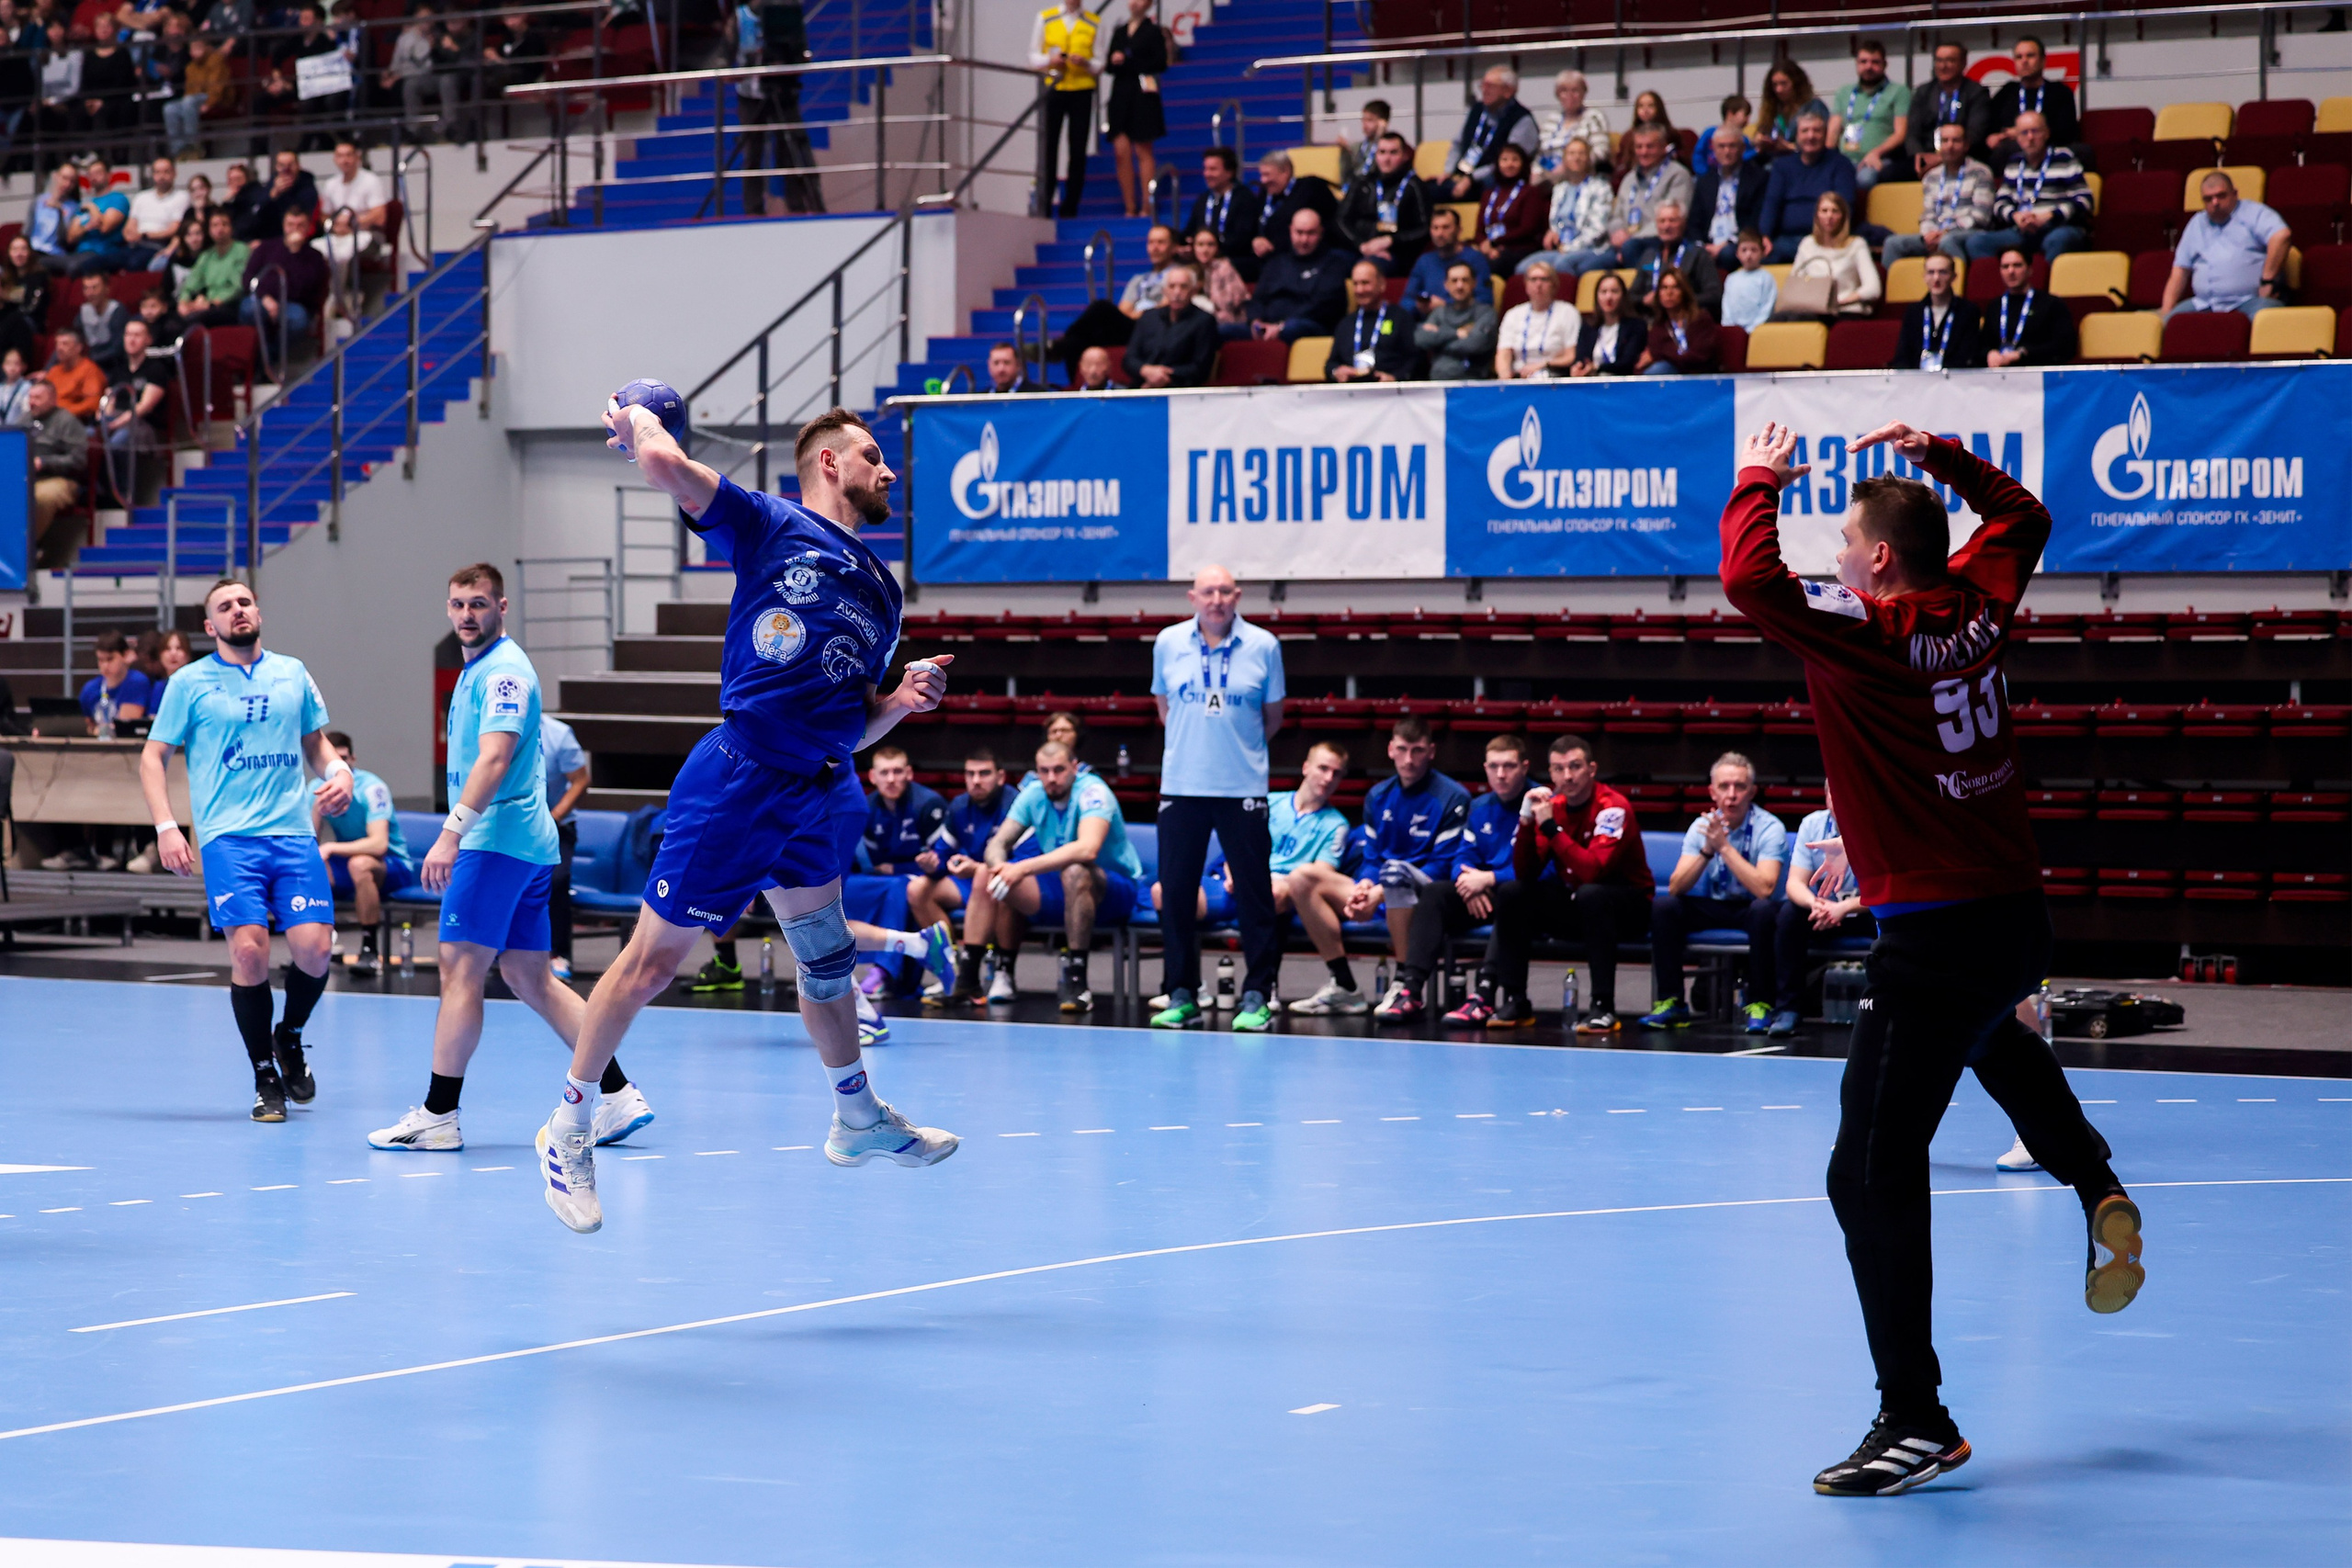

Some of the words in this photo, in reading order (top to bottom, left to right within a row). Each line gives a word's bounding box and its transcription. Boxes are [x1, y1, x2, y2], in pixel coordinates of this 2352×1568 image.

[1188, 445, 1426, 524] ГАЗПРОМ
[1544, 468, 1678, 509] ГАЗПРОМ
[2155, 457, 2303, 501] ГАЗПРОМ
[1001, 479, 1120, 519] ГАЗПРОМ
[1487, 516, 1563, 534] ГЕНЕРАЛЬНЫЙ
[1564, 517, 1613, 533] СПОНСОР
[2091, 509, 2175, 527] ГЕНЕРАЛЬНЫЙ
[2177, 510, 2233, 526] СПОНСОР
[2234, 511, 2249, 525] ГК
[836, 602, 878, 646] AVANSUM
[761, 642, 787, 660] Лёва
[240, 694, 268, 723] 77
[1930, 664, 1998, 753] 93
[247, 753, 298, 770] ГАЗПРОМ
[1961, 775, 1988, 790] NORD
[687, 907, 723, 922] Kempa
